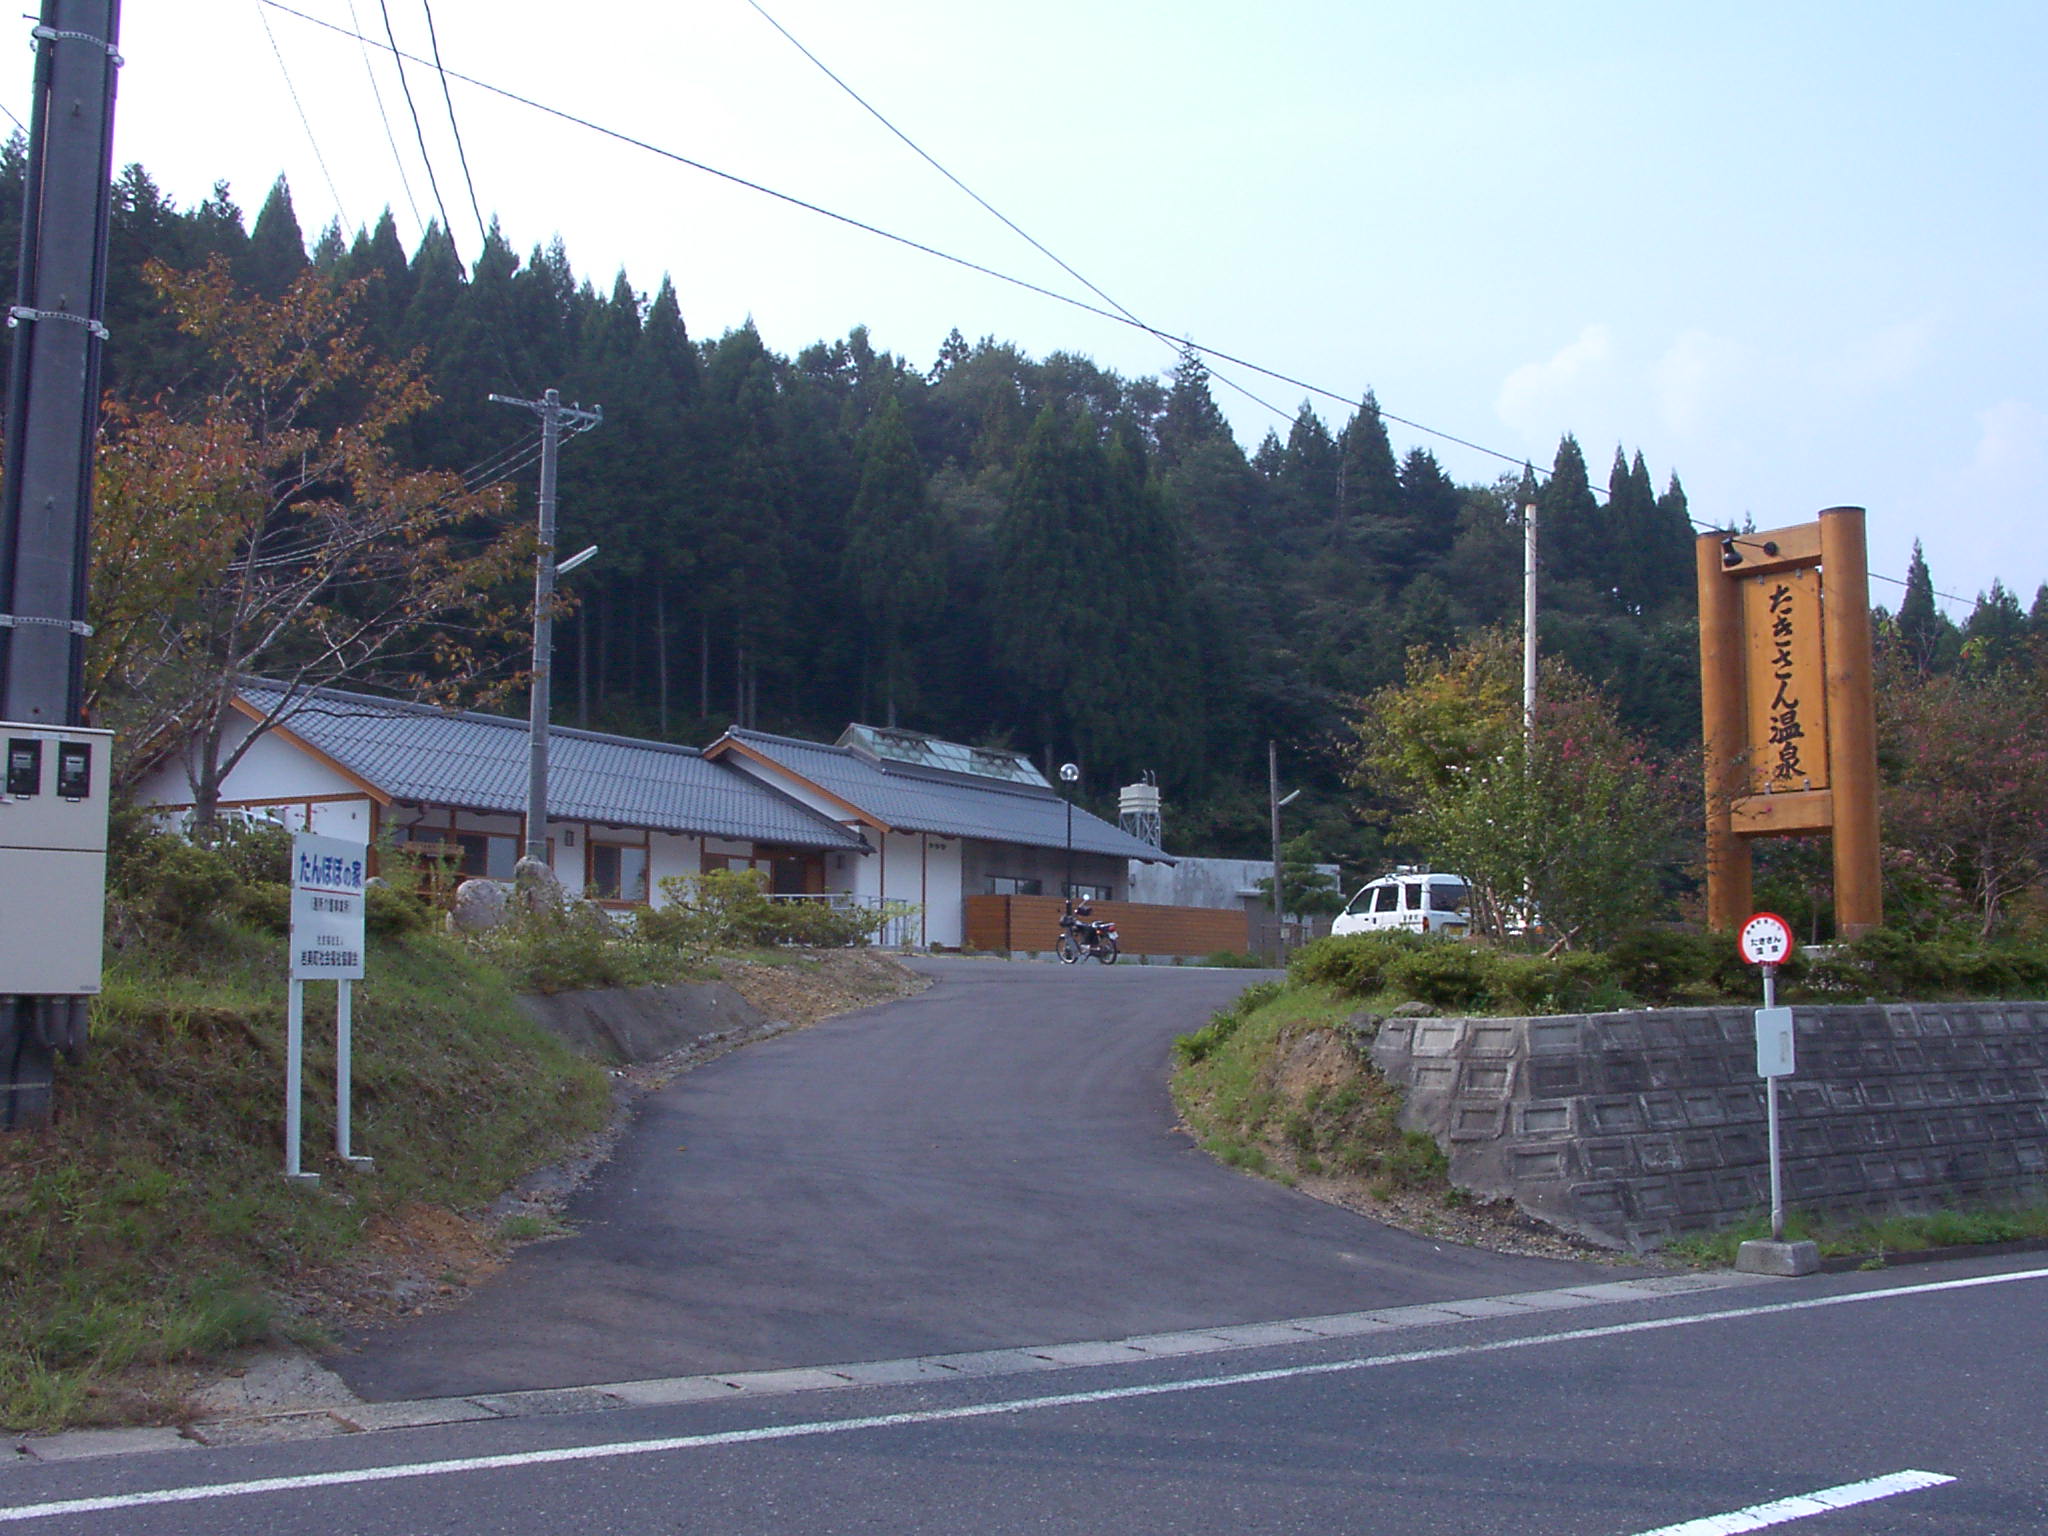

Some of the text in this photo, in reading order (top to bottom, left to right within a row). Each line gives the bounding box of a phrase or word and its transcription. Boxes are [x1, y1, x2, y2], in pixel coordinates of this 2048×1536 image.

[1769, 584, 1806, 780] たきさん温泉
[300, 852, 362, 889] たんぽぽの家
